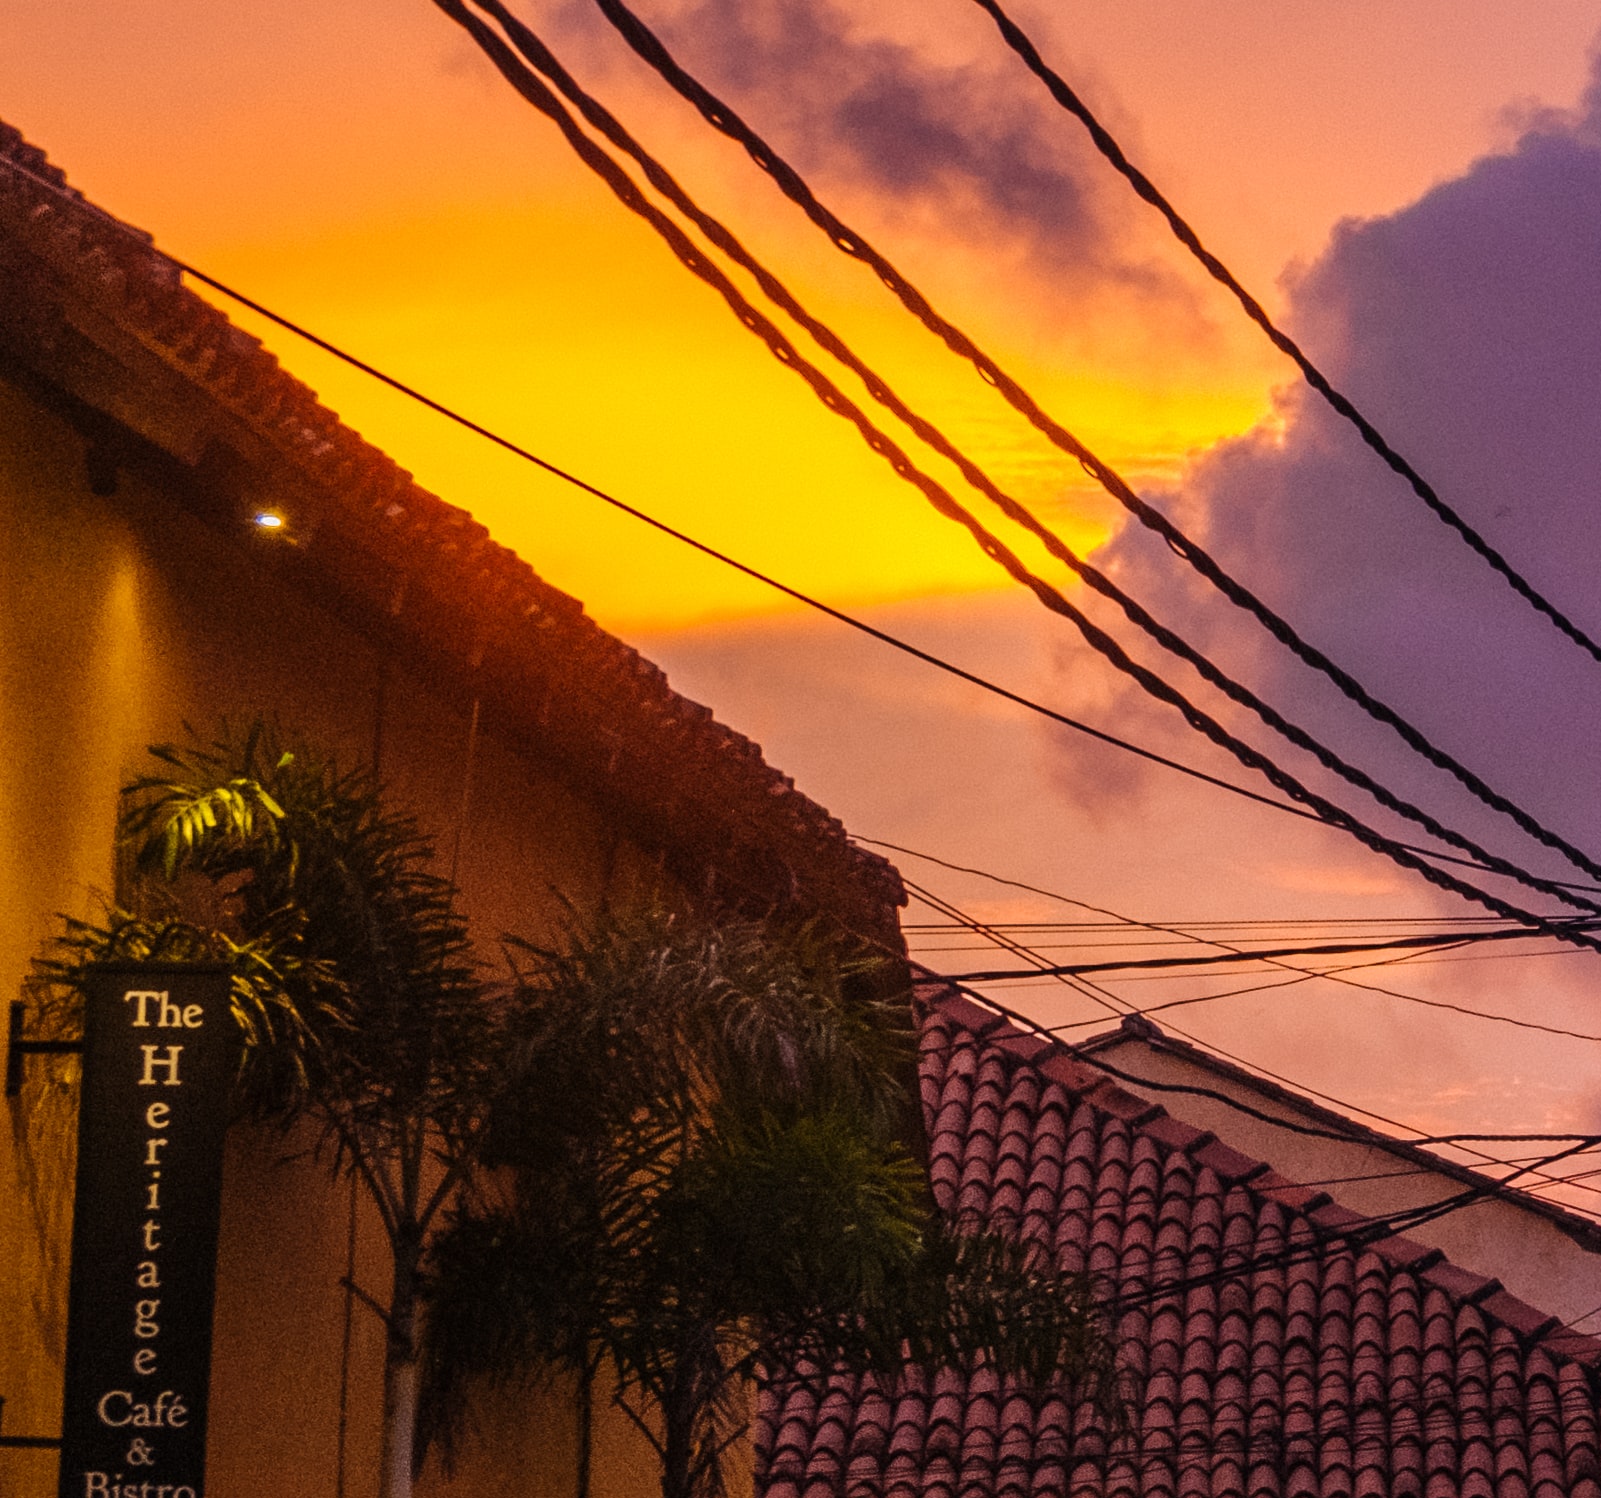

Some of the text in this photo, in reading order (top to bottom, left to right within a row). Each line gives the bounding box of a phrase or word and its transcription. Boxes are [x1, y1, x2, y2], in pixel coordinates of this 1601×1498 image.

[124, 990, 205, 1030] The
[133, 1044, 184, 1376] Heritage
[98, 1389, 189, 1429] Café
[126, 1438, 155, 1467] &
